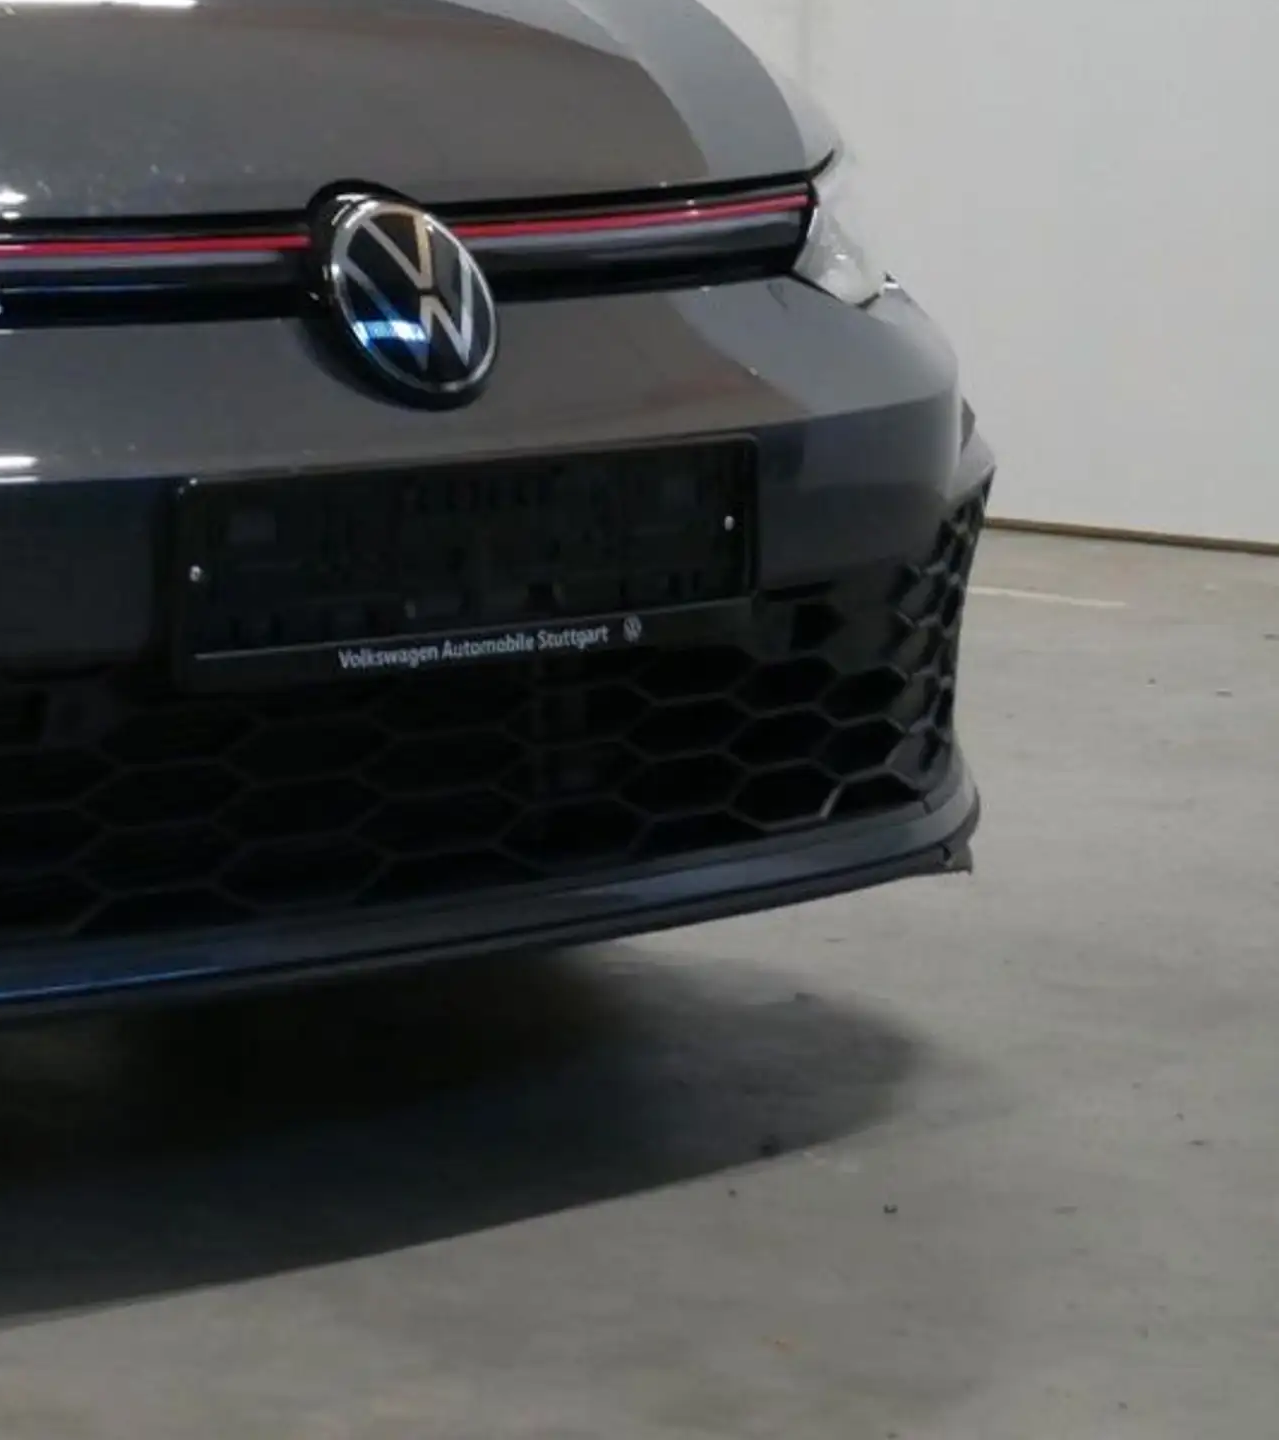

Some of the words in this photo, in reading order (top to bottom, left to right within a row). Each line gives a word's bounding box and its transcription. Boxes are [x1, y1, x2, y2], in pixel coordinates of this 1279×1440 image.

[338, 646, 439, 669] Volkswagen
[442, 633, 535, 660] Automobile
[537, 623, 610, 650] Stuttgart
